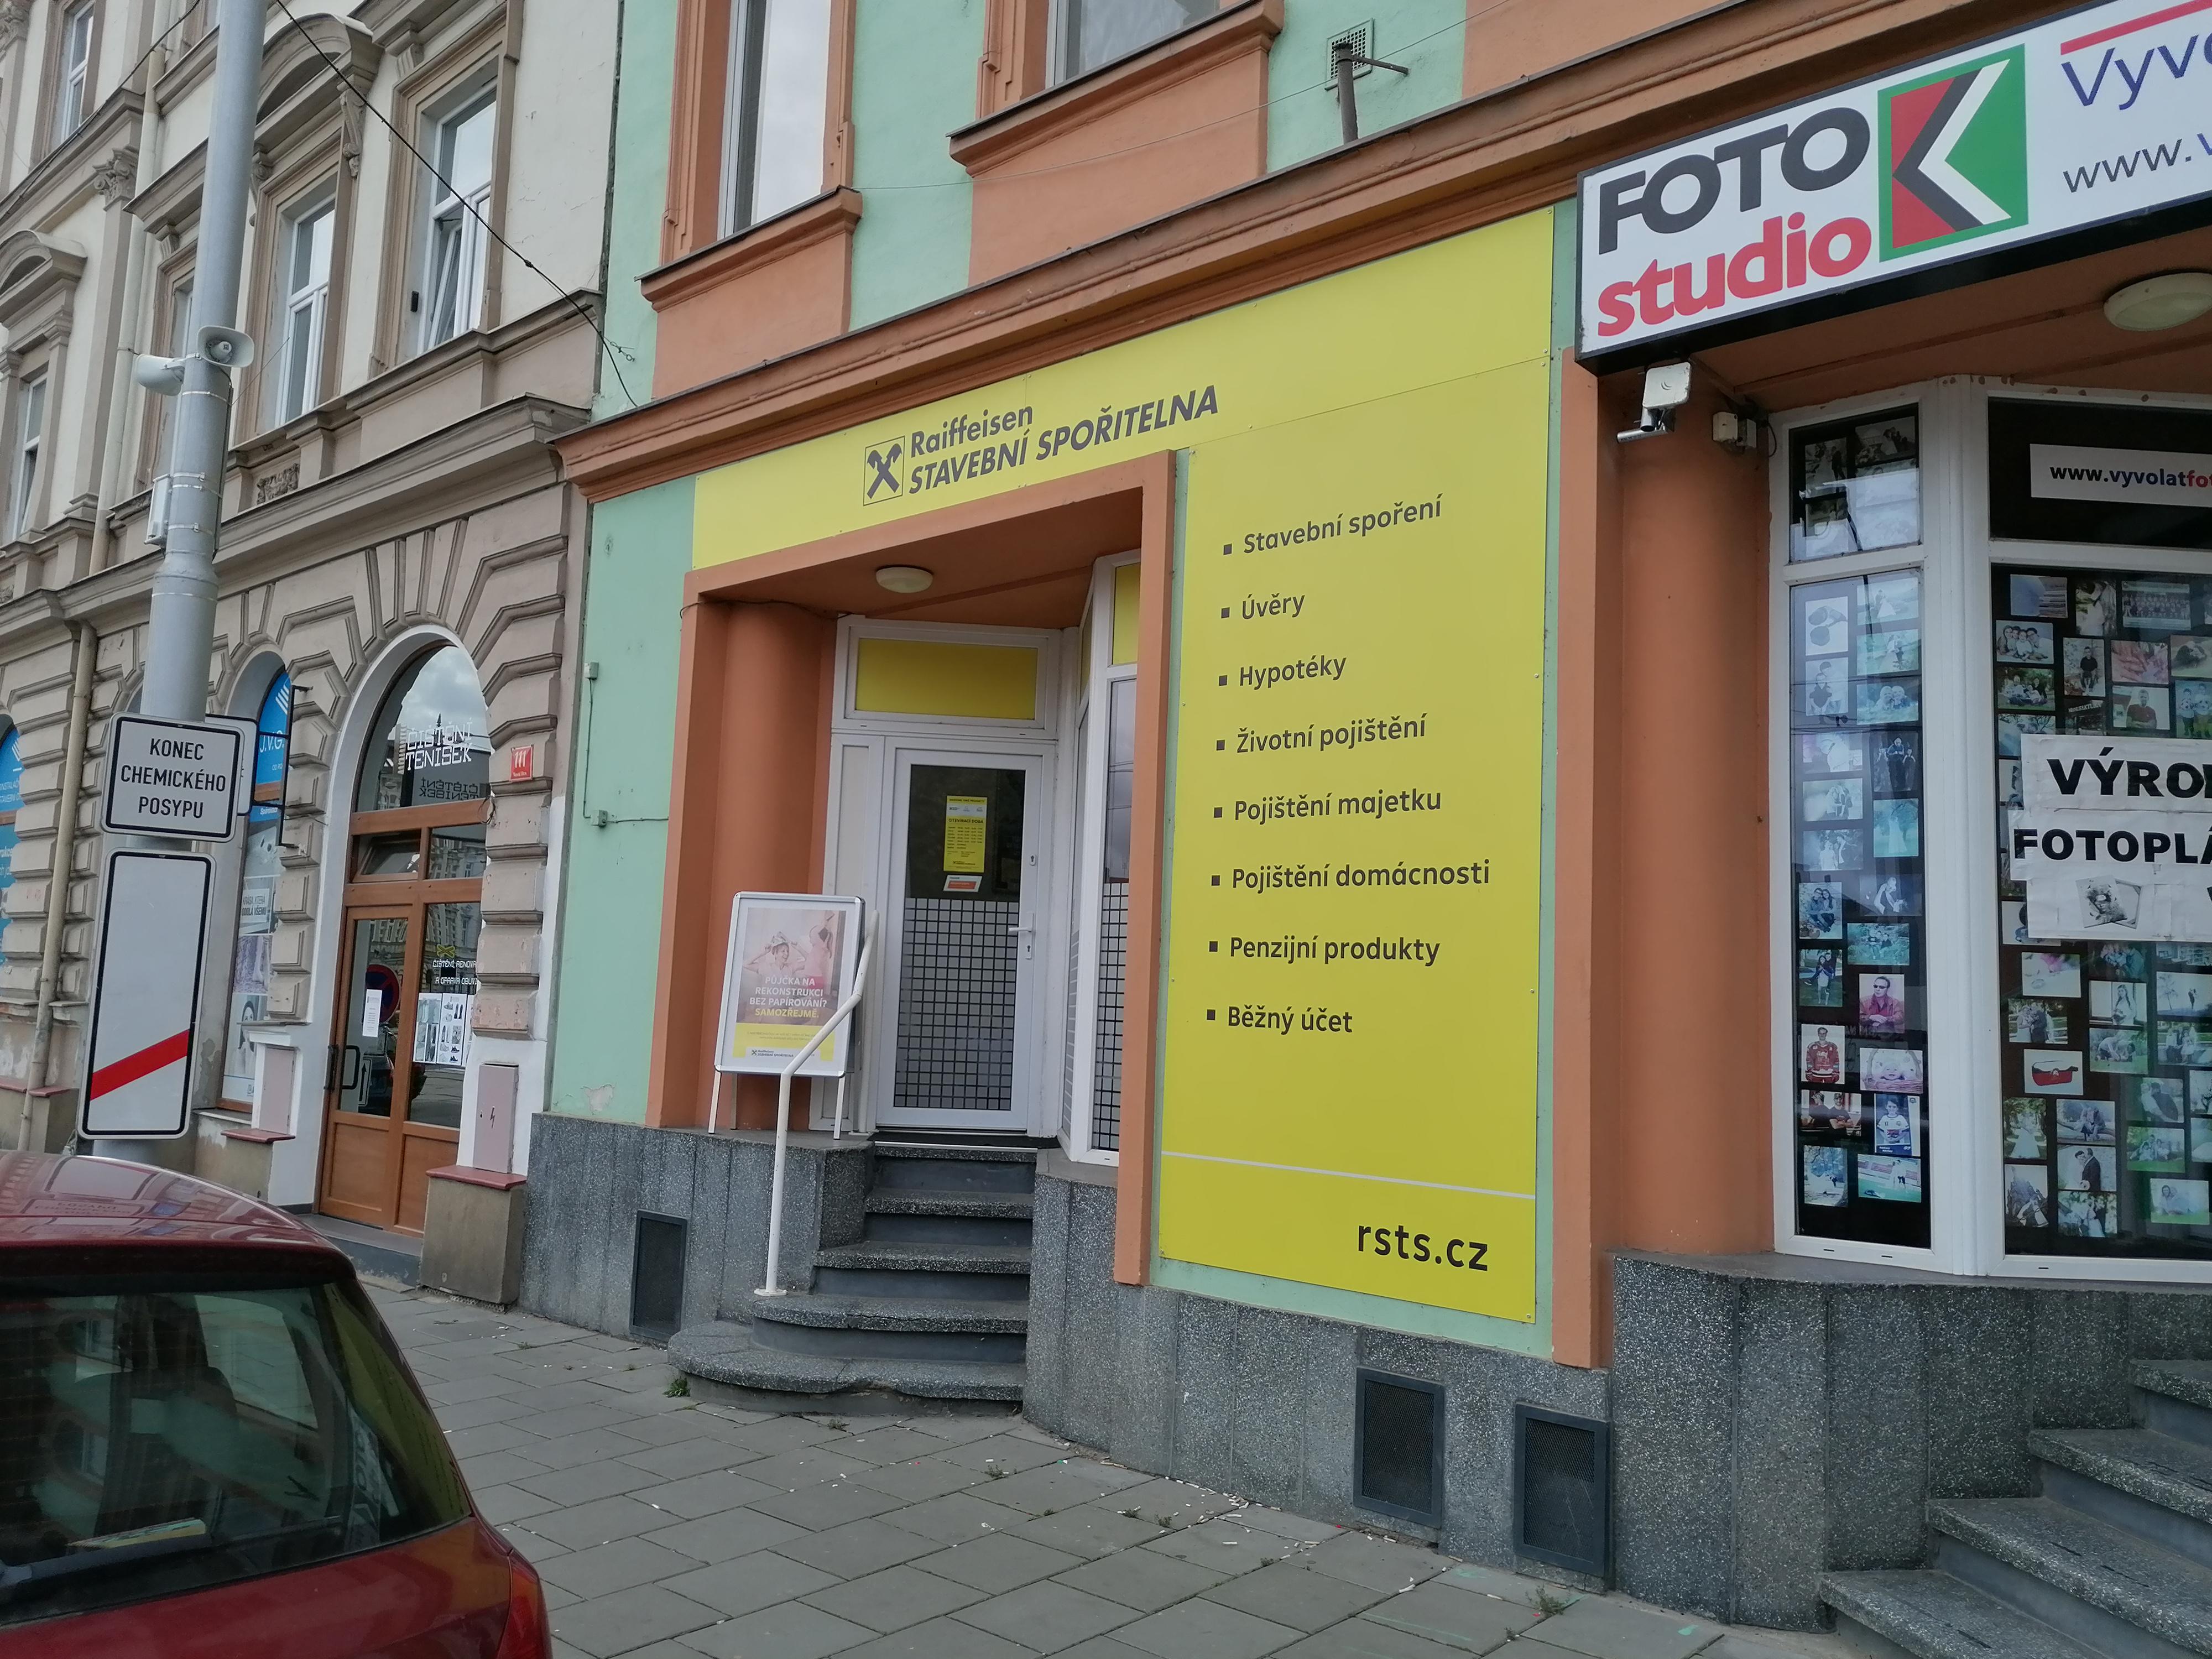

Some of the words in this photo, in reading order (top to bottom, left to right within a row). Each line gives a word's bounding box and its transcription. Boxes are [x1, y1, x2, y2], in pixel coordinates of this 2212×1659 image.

[1599, 107, 1871, 255] FOTO
[1598, 211, 1872, 337] studio
[909, 429, 1030, 494] STAVEBNÍ
[1036, 385, 1218, 461] SPOŘITELNA
[911, 405, 1033, 458] Raiffeisen
[1244, 513, 1343, 554] Stavební
[1348, 493, 1443, 536] spoření
[1241, 593, 1305, 619] Úvěry
[1239, 654, 1347, 690] Hypotéky
[149, 738, 204, 760] KONEC
[408, 717, 473, 750] ČIŠTĚNÍ
[1237, 724, 1314, 753] Životní
[1320, 712, 1427, 751] pojištění
[405, 743, 472, 770] TENISEK
[515, 750, 526, 769] 111
[2047, 747, 2212, 799] VÝRO
[121, 765, 226, 792] CHEMICKÉHO
[138, 796, 204, 818] POSYPU
[1235, 792, 1332, 825] Pojištění
[1338, 788, 1441, 819] majetku
[2014, 826, 2212, 864] FOTOPL
[1233, 863, 1331, 894] Pojištění
[1335, 859, 1490, 886] domácnosti
[1230, 935, 1318, 964] Penzijní
[1324, 936, 1440, 967] produkty
[755, 987, 823, 997] REKONSTRUKCI
[765, 975, 801, 985] PŮJČKA
[755, 1008, 819, 1018] SAMOZŘEJMĚ.
[768, 997, 827, 1007] PAPÍROVÁNÍ?
[1228, 1004, 1294, 1035] Běžný
[1301, 1007, 1353, 1032] účet
[1358, 1224, 1488, 1271] rsts.cz
